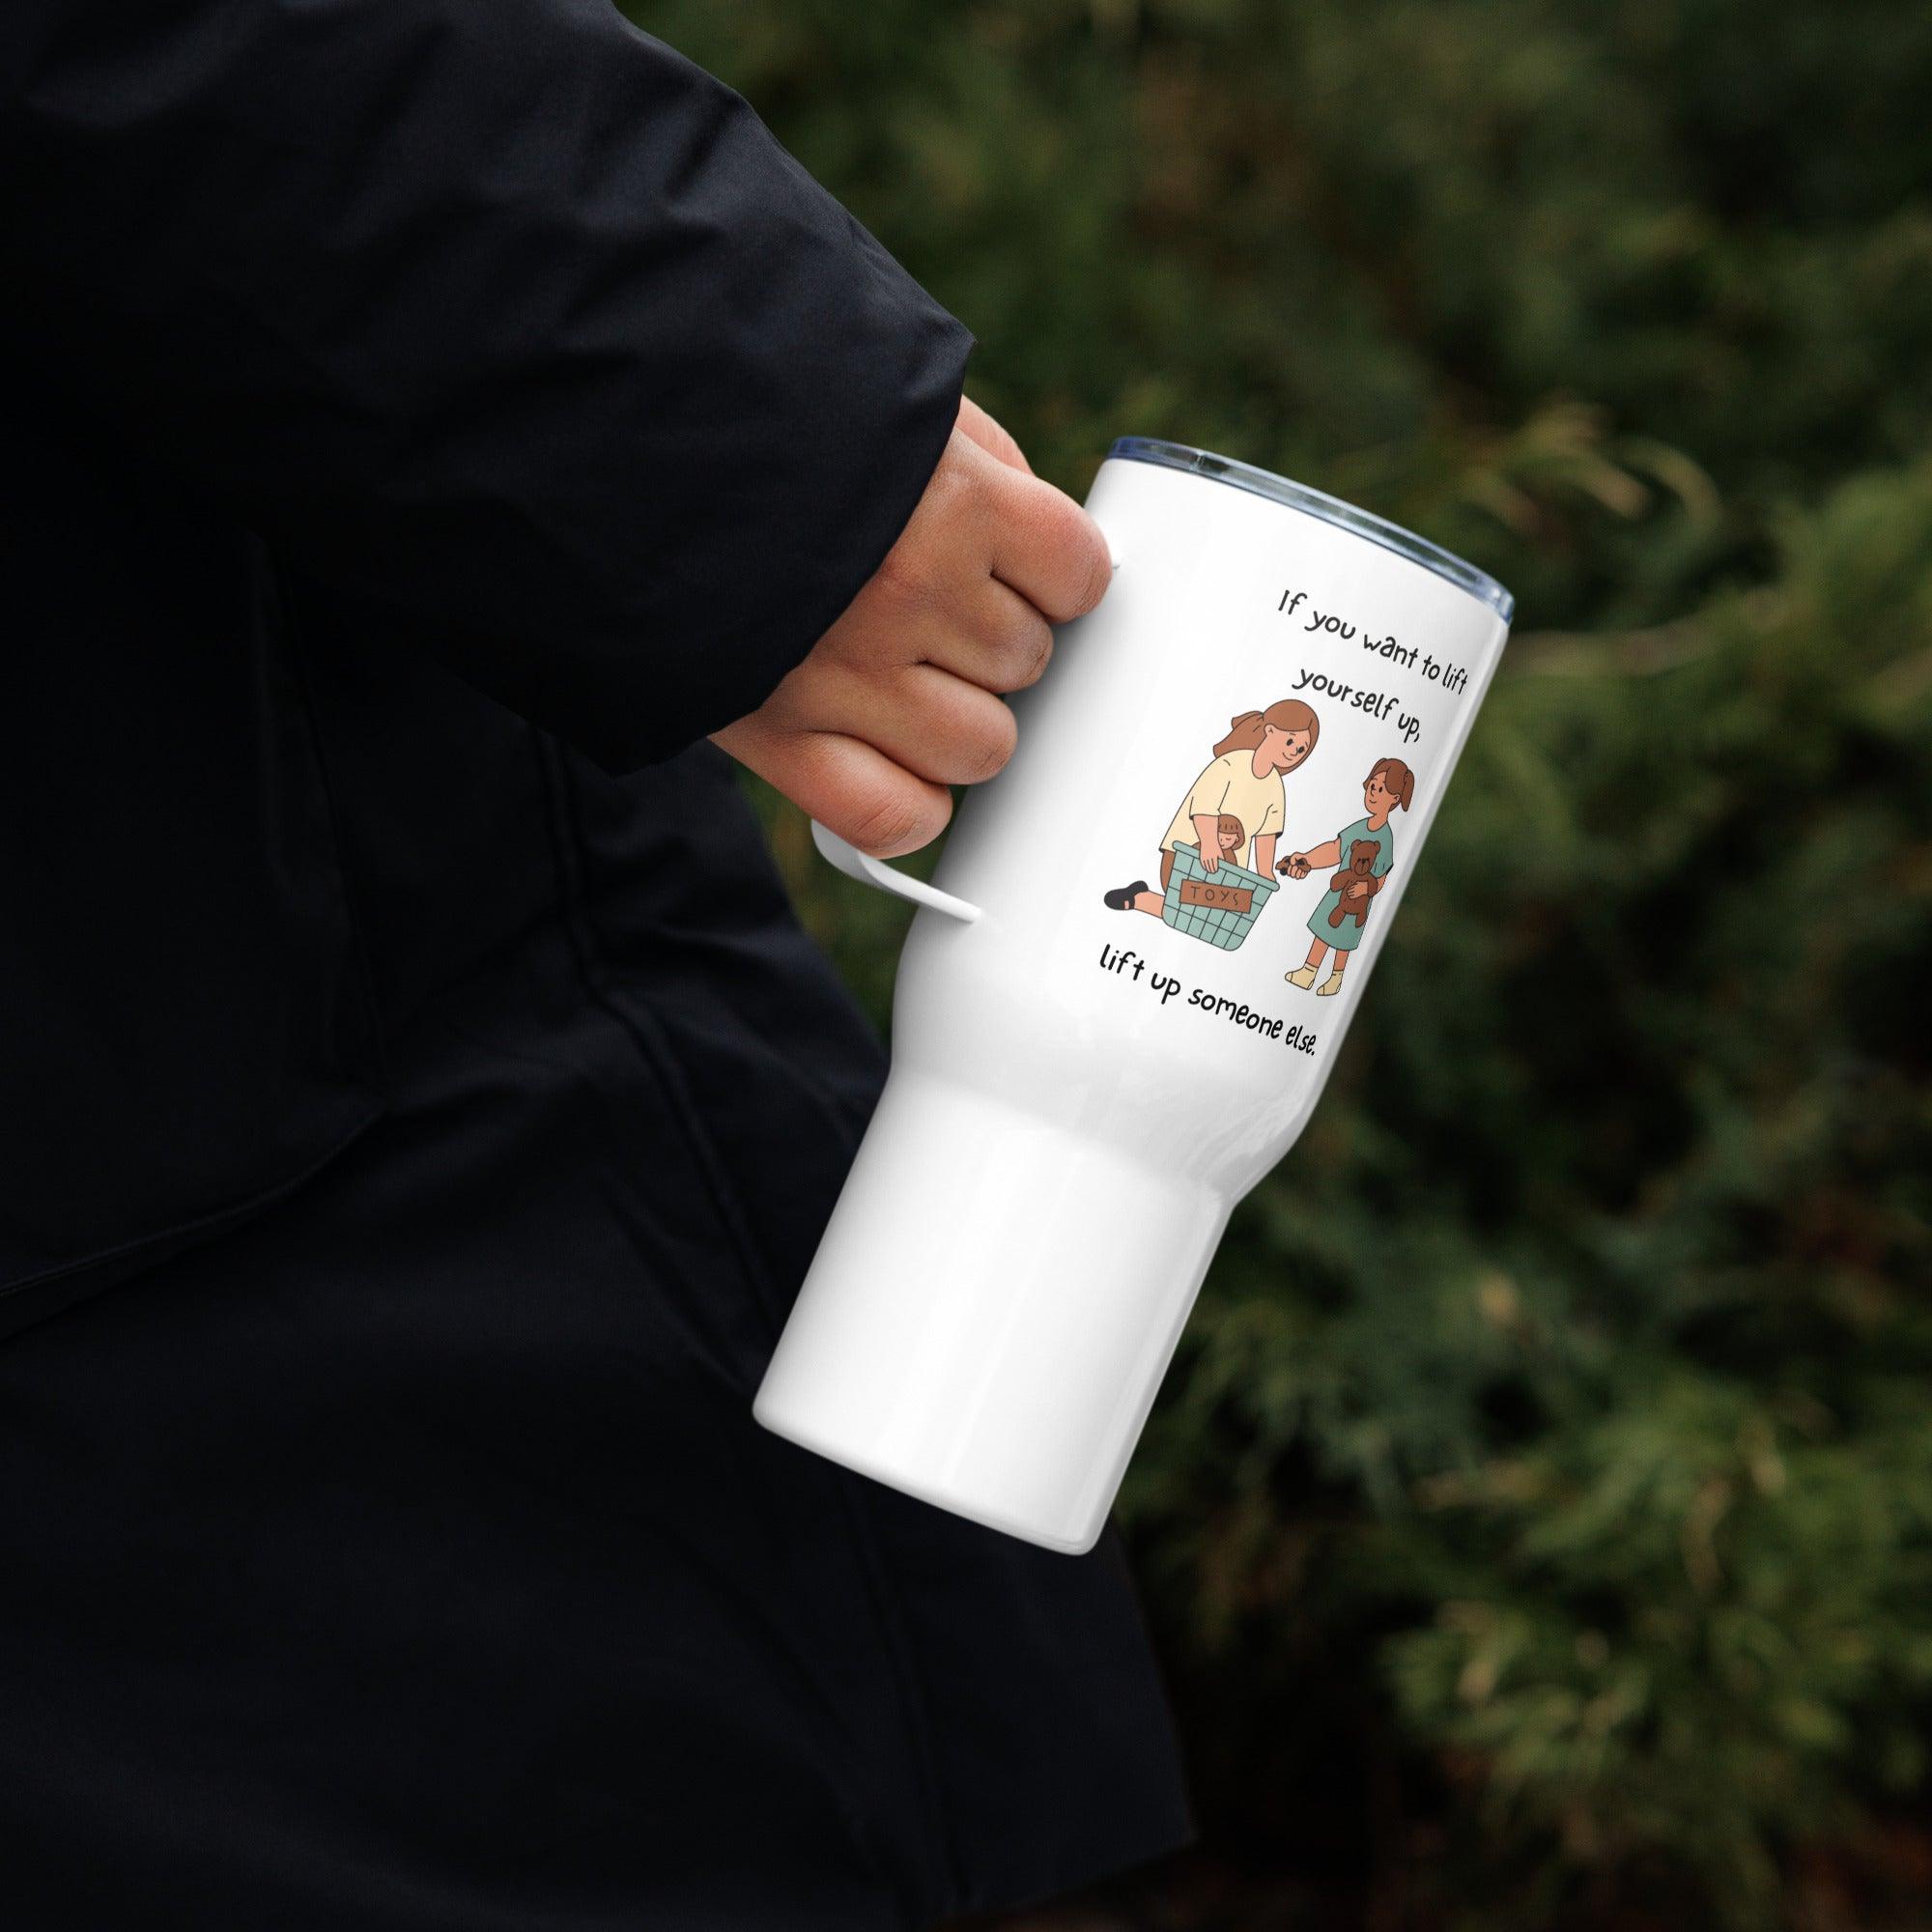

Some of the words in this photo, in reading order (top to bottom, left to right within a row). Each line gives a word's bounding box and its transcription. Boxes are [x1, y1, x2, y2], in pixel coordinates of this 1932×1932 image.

[1278, 589, 1308, 615] If
[1304, 611, 1356, 639] you
[1363, 634, 1419, 669] want
[1421, 654, 1441, 681] to
[1441, 663, 1468, 696] lift
[1291, 668, 1400, 721] yourself
[1397, 712, 1421, 744] up,
[1190, 885, 1238, 906] TOYS
[1099, 943, 1145, 981] lift
[1151, 972, 1181, 1006] up
[1187, 988, 1284, 1039] someone
[1285, 1025, 1317, 1057] else.
